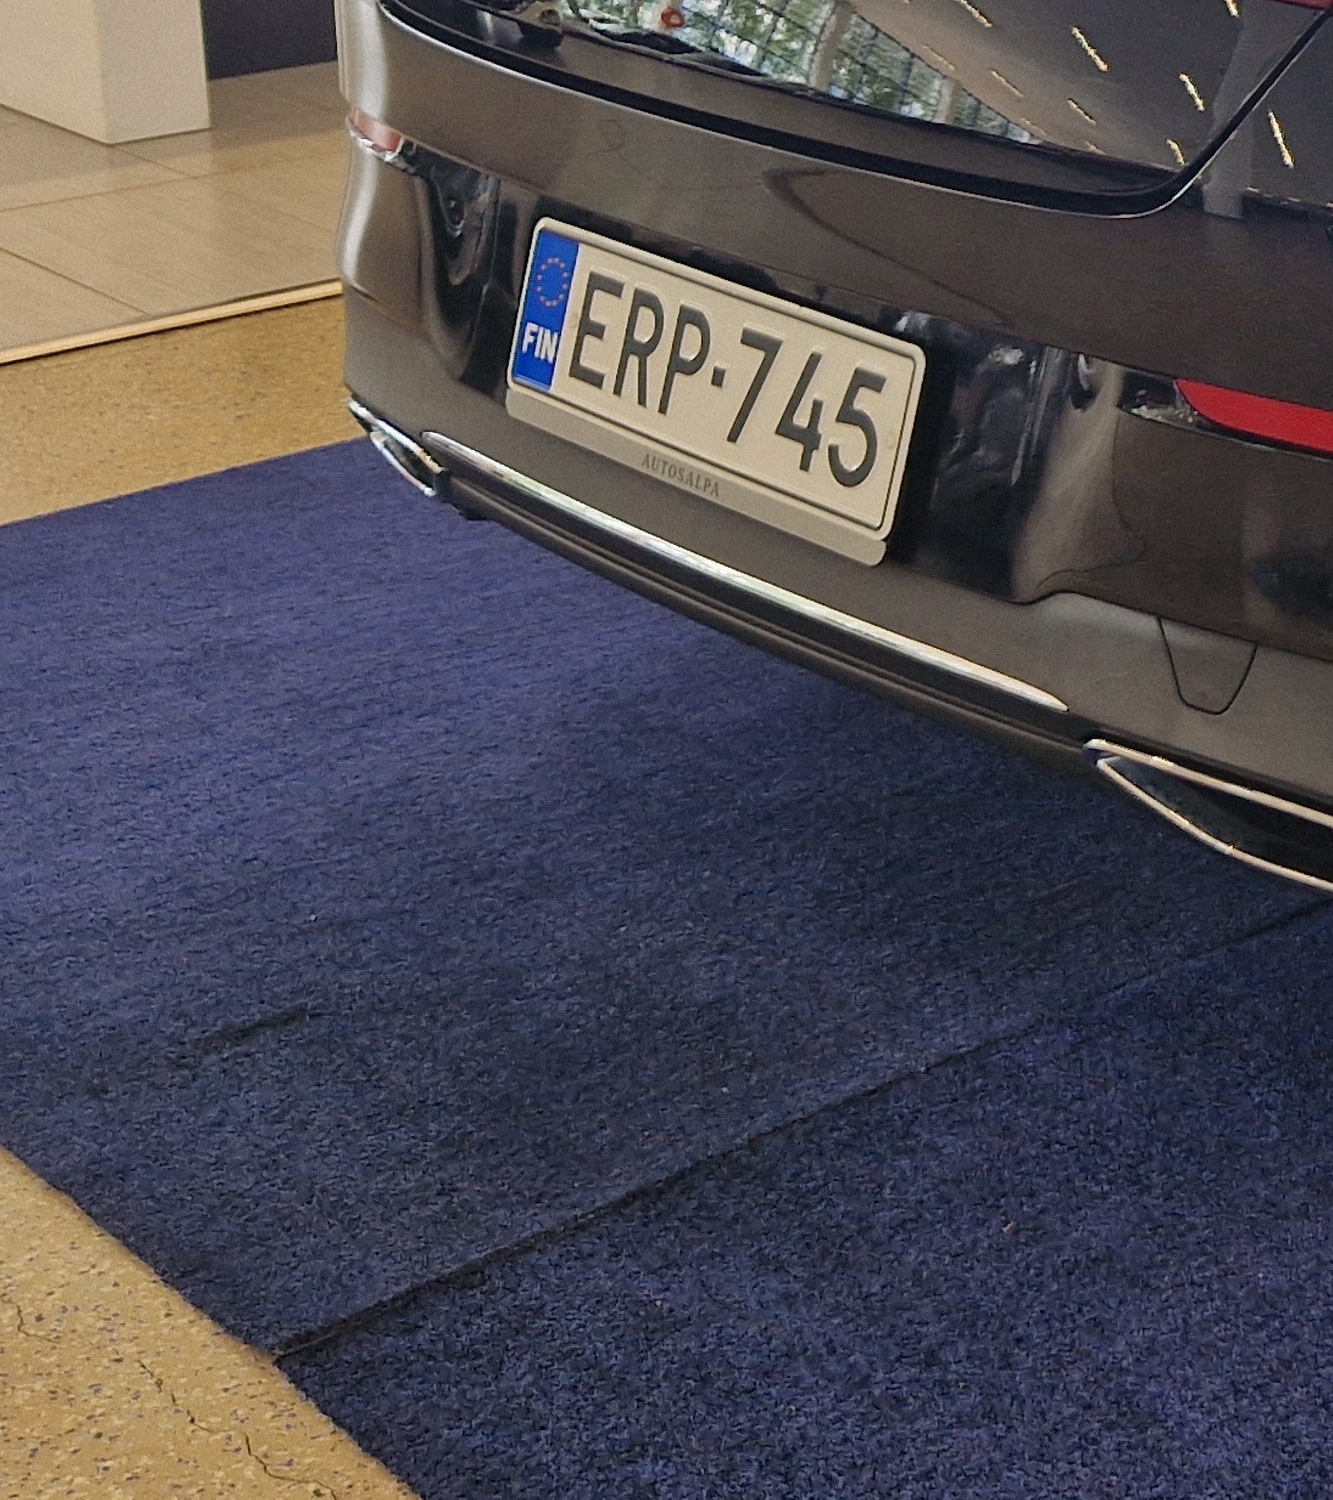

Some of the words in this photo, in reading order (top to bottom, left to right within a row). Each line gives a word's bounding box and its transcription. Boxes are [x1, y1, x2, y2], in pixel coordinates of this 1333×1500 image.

[522, 322, 559, 364] FIN
[568, 271, 887, 487] ERP-745
[641, 453, 719, 497] AUTOSALPA
